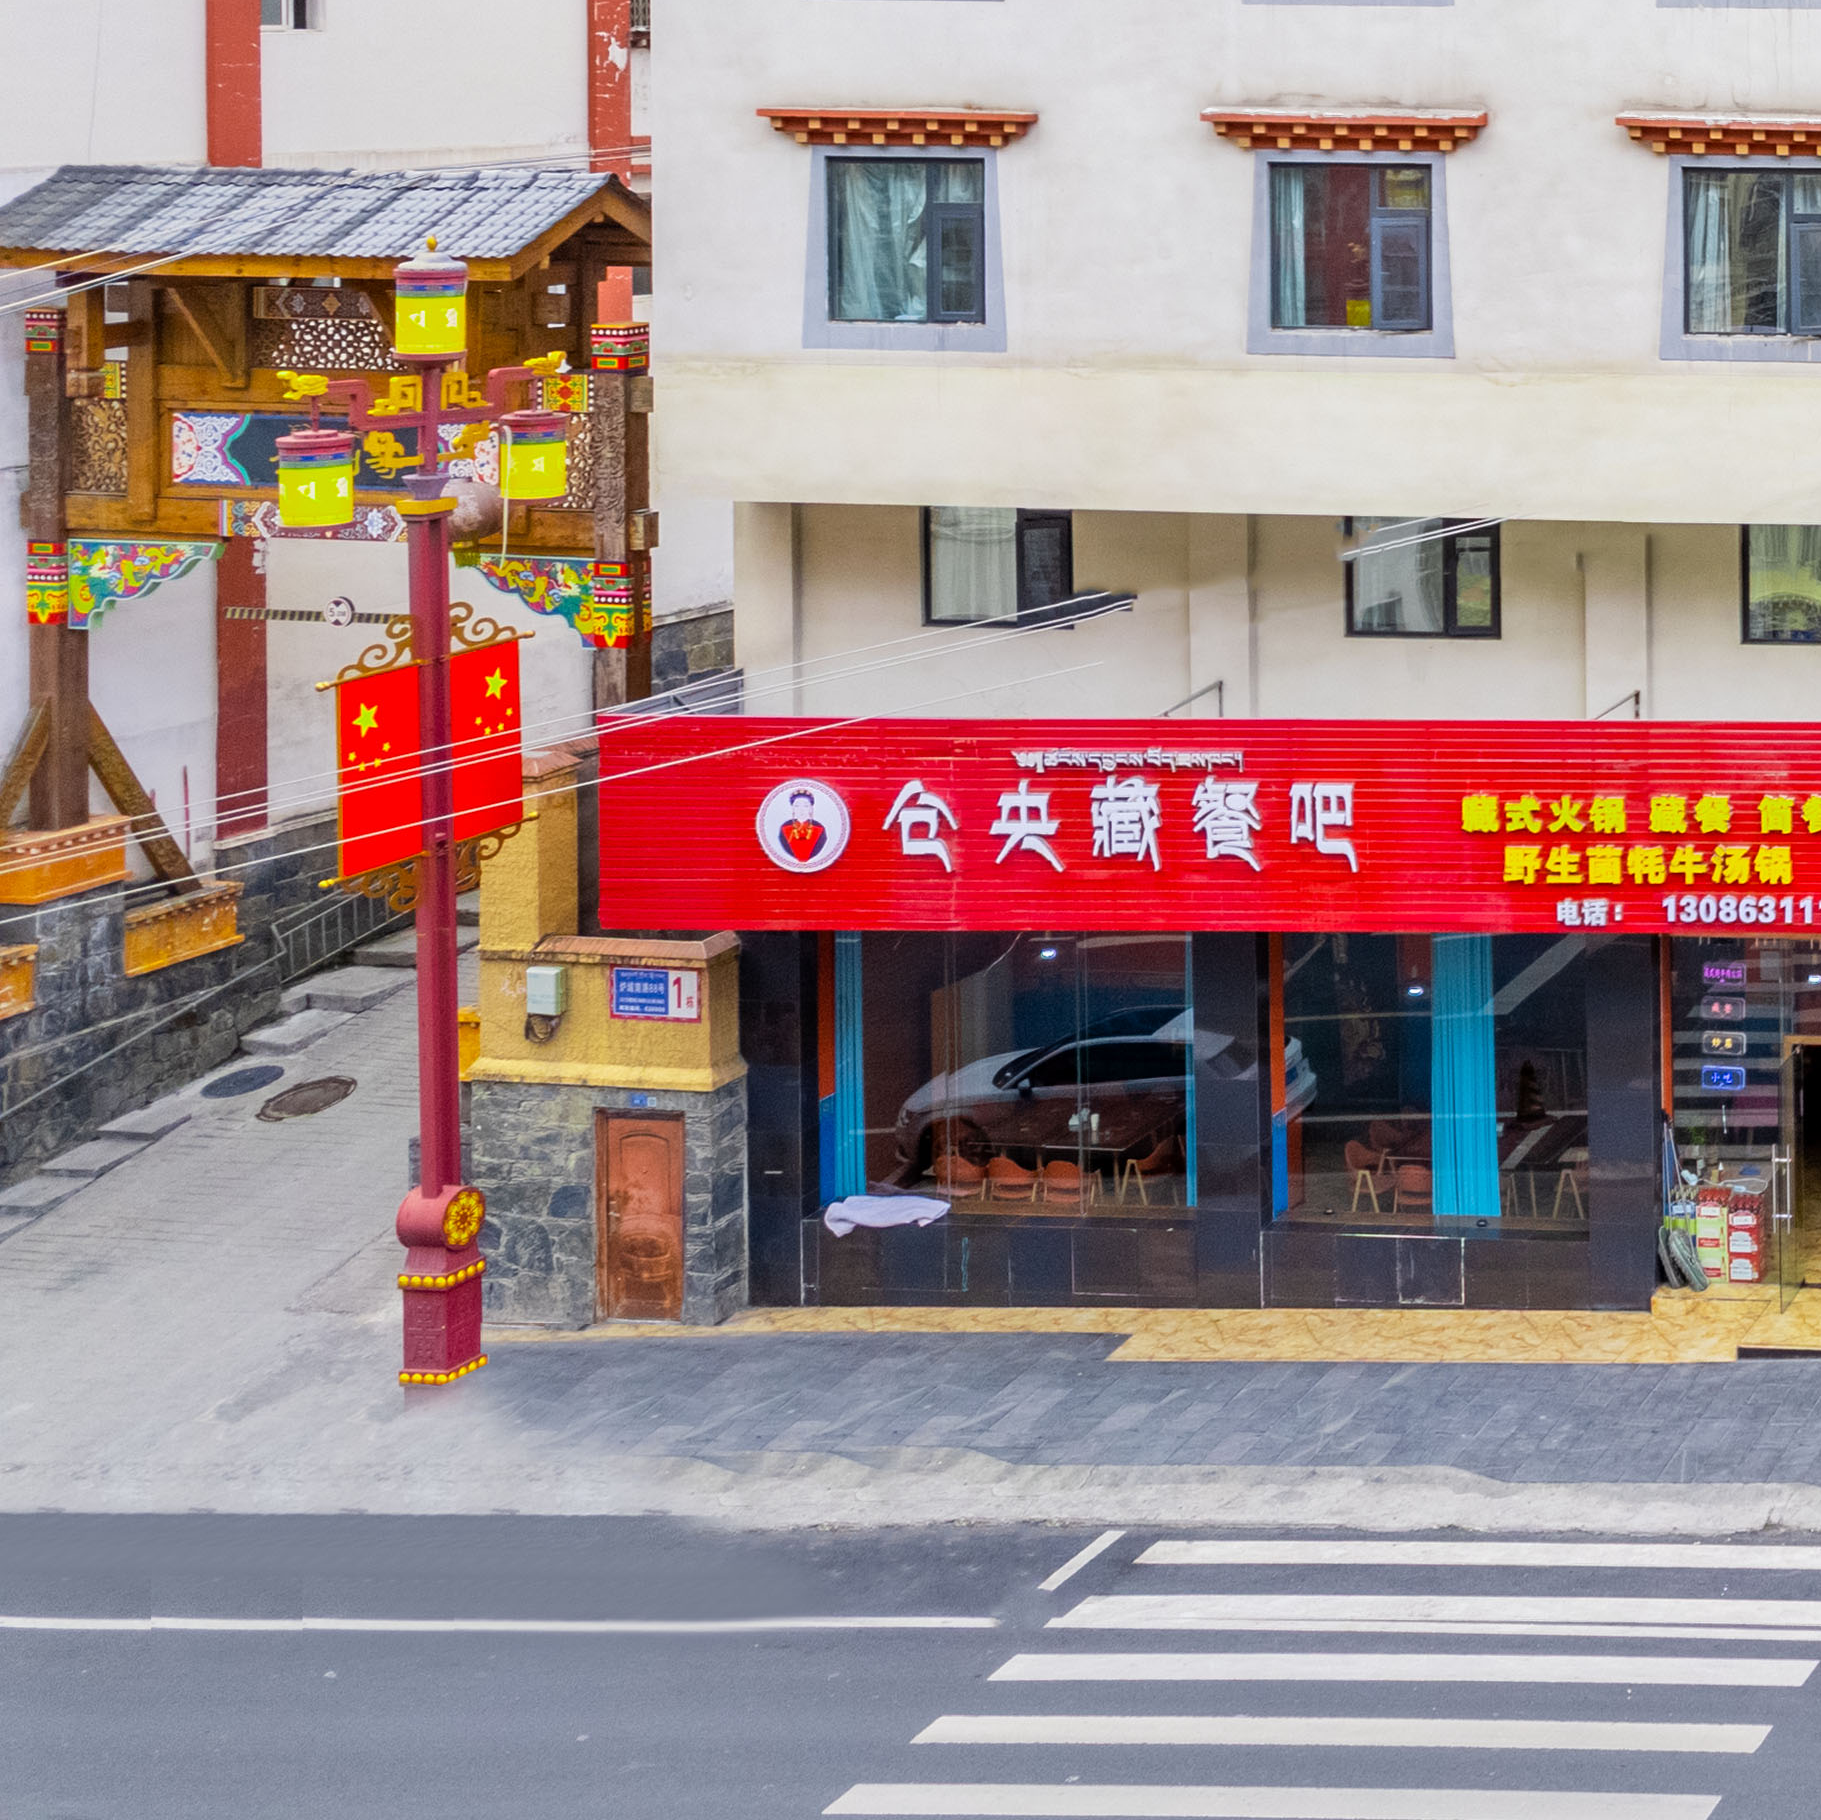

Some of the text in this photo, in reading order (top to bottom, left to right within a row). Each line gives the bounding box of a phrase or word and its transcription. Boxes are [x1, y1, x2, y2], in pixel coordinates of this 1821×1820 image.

[1461, 794, 1628, 834] 藏式火锅
[1648, 793, 1741, 834] 藏餐
